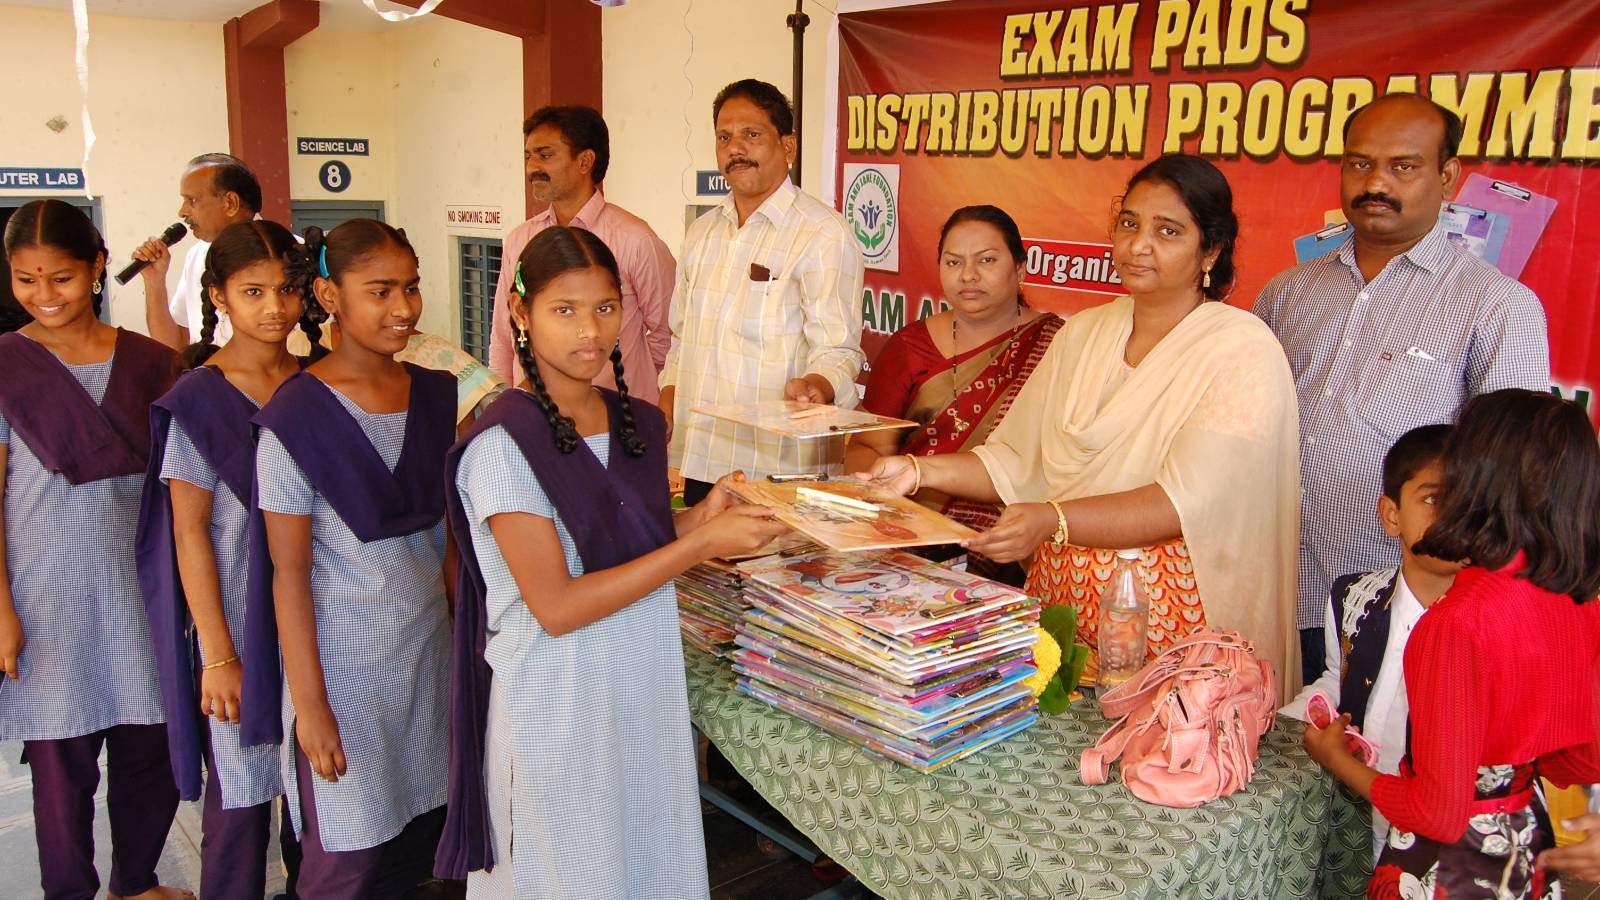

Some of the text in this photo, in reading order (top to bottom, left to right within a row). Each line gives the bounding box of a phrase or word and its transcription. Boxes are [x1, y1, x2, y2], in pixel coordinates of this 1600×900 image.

[1001, 0, 1307, 78] EXAM PADS
[847, 66, 1600, 158] DISTRIBUTION PROGRMME
[300, 141, 365, 153] SCIENCE LAB
[45, 173, 79, 185] LAB
[327, 164, 342, 188] 8
[850, 184, 861, 202] AND
[872, 174, 894, 228] FOUNDATION
[447, 210, 501, 224] NO SMOKING ZONE
